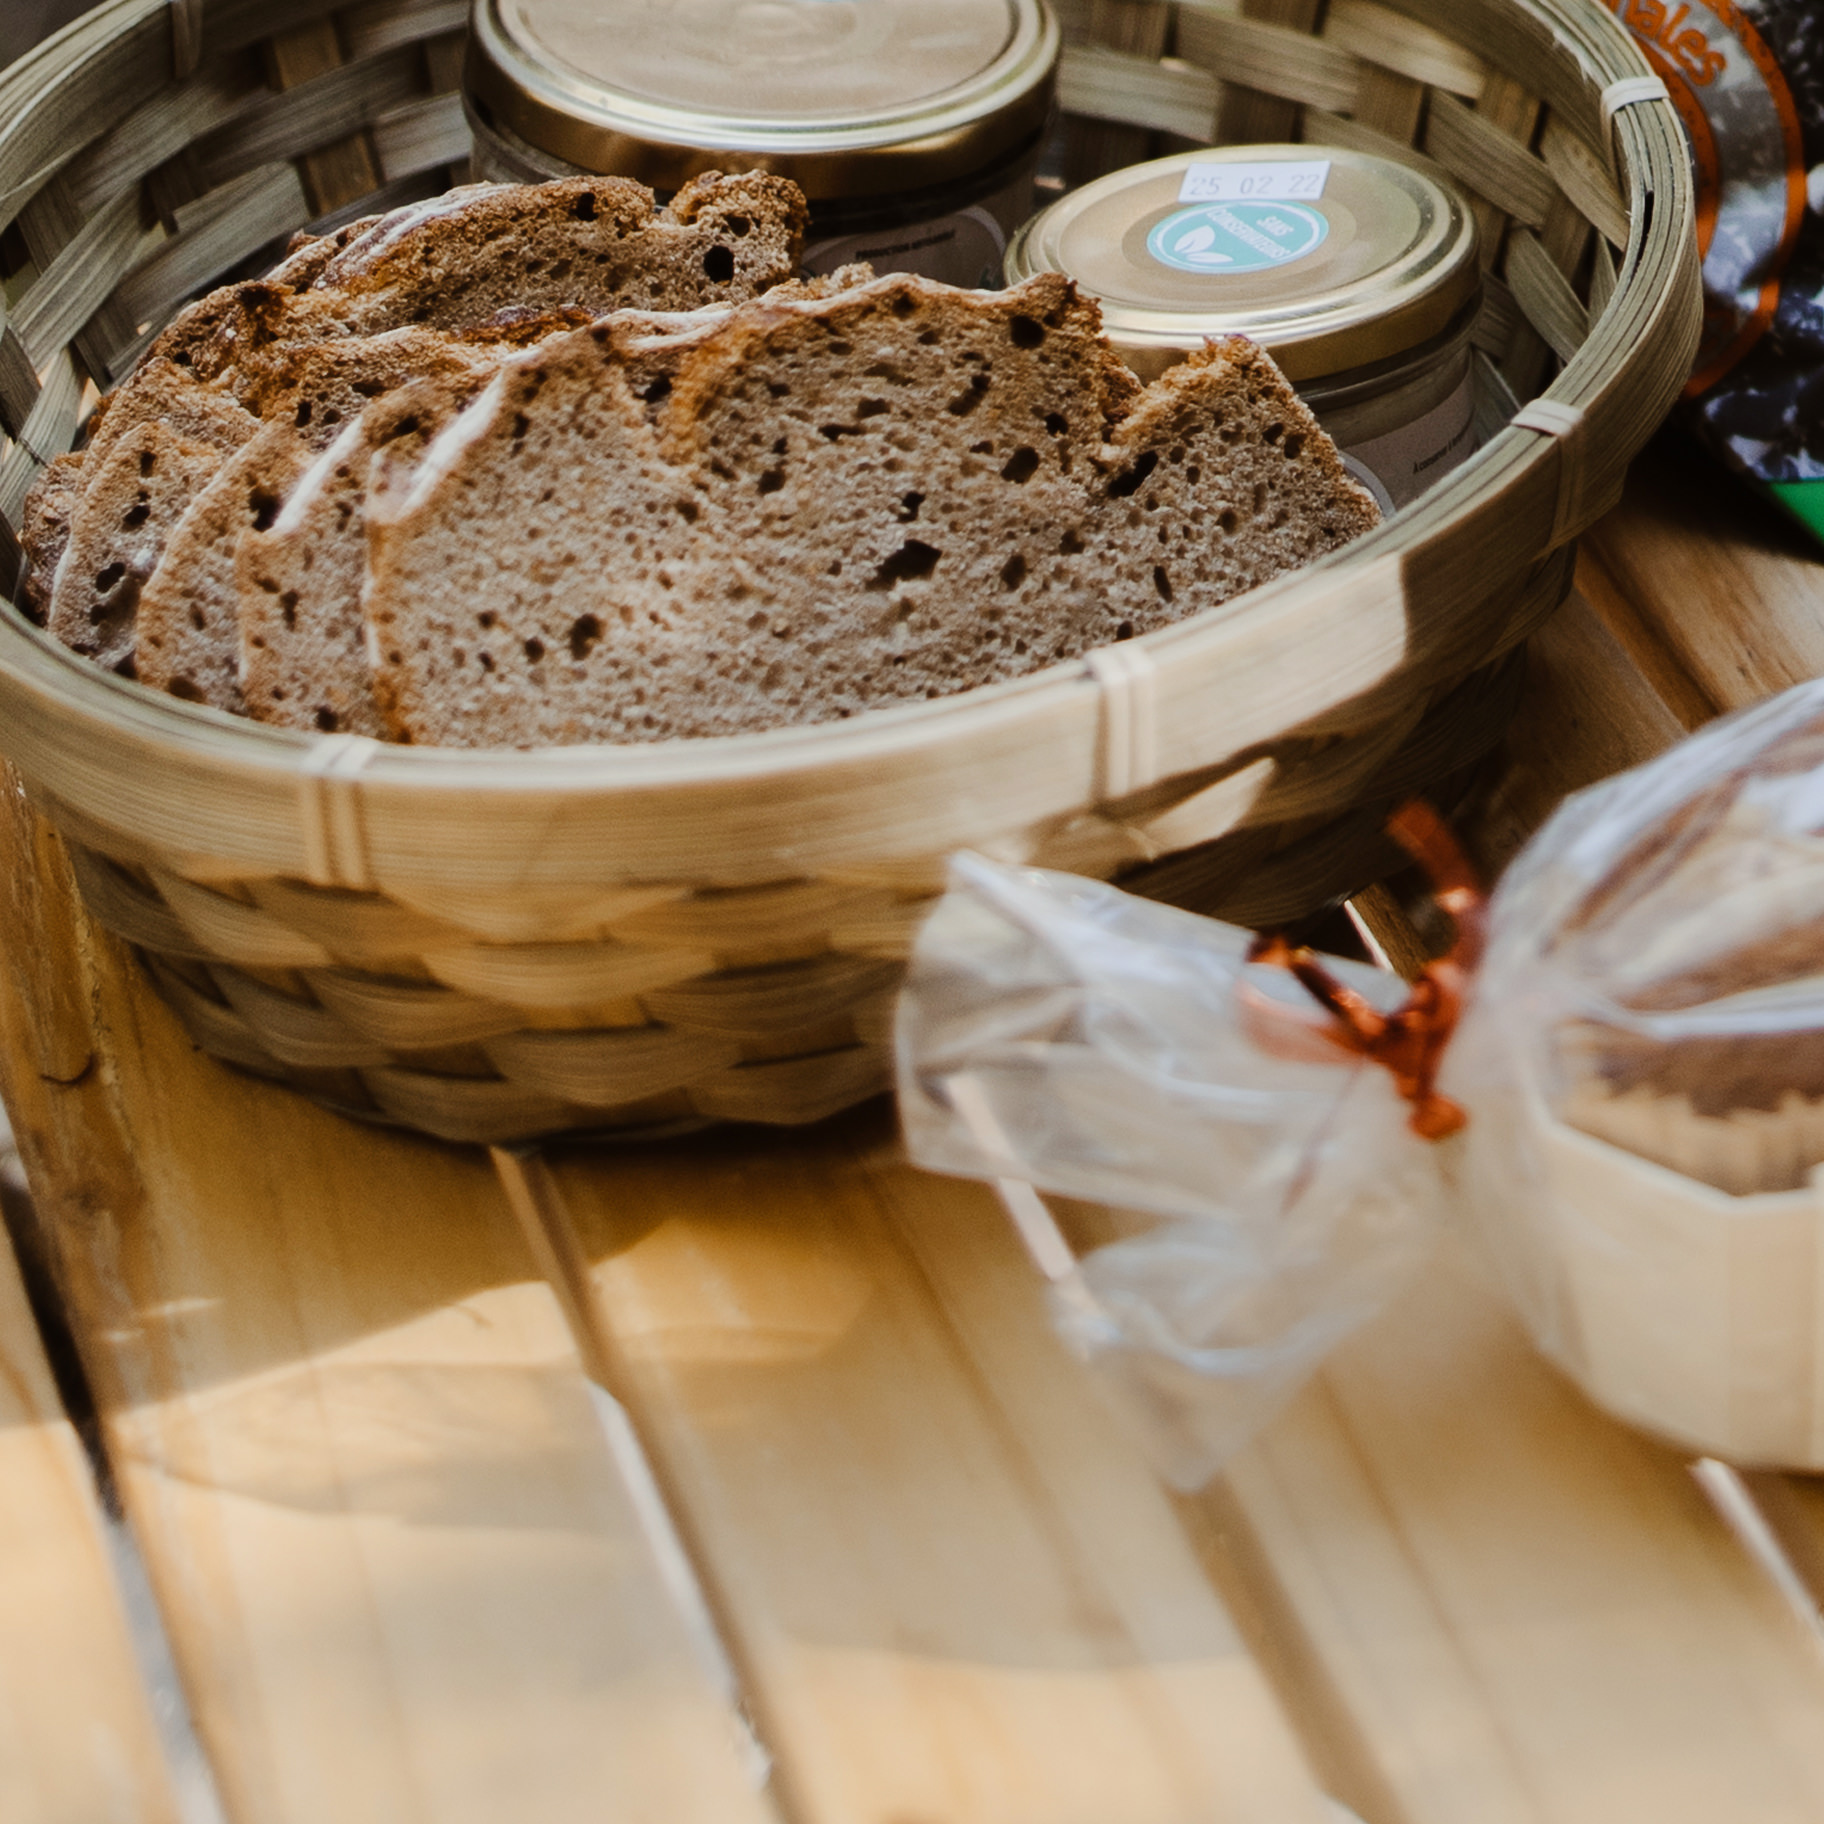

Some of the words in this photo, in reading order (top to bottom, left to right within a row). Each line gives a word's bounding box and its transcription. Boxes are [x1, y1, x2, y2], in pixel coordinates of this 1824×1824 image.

[1189, 176, 1223, 195] 25
[1240, 176, 1273, 194] 02
[1288, 174, 1321, 193] 22
